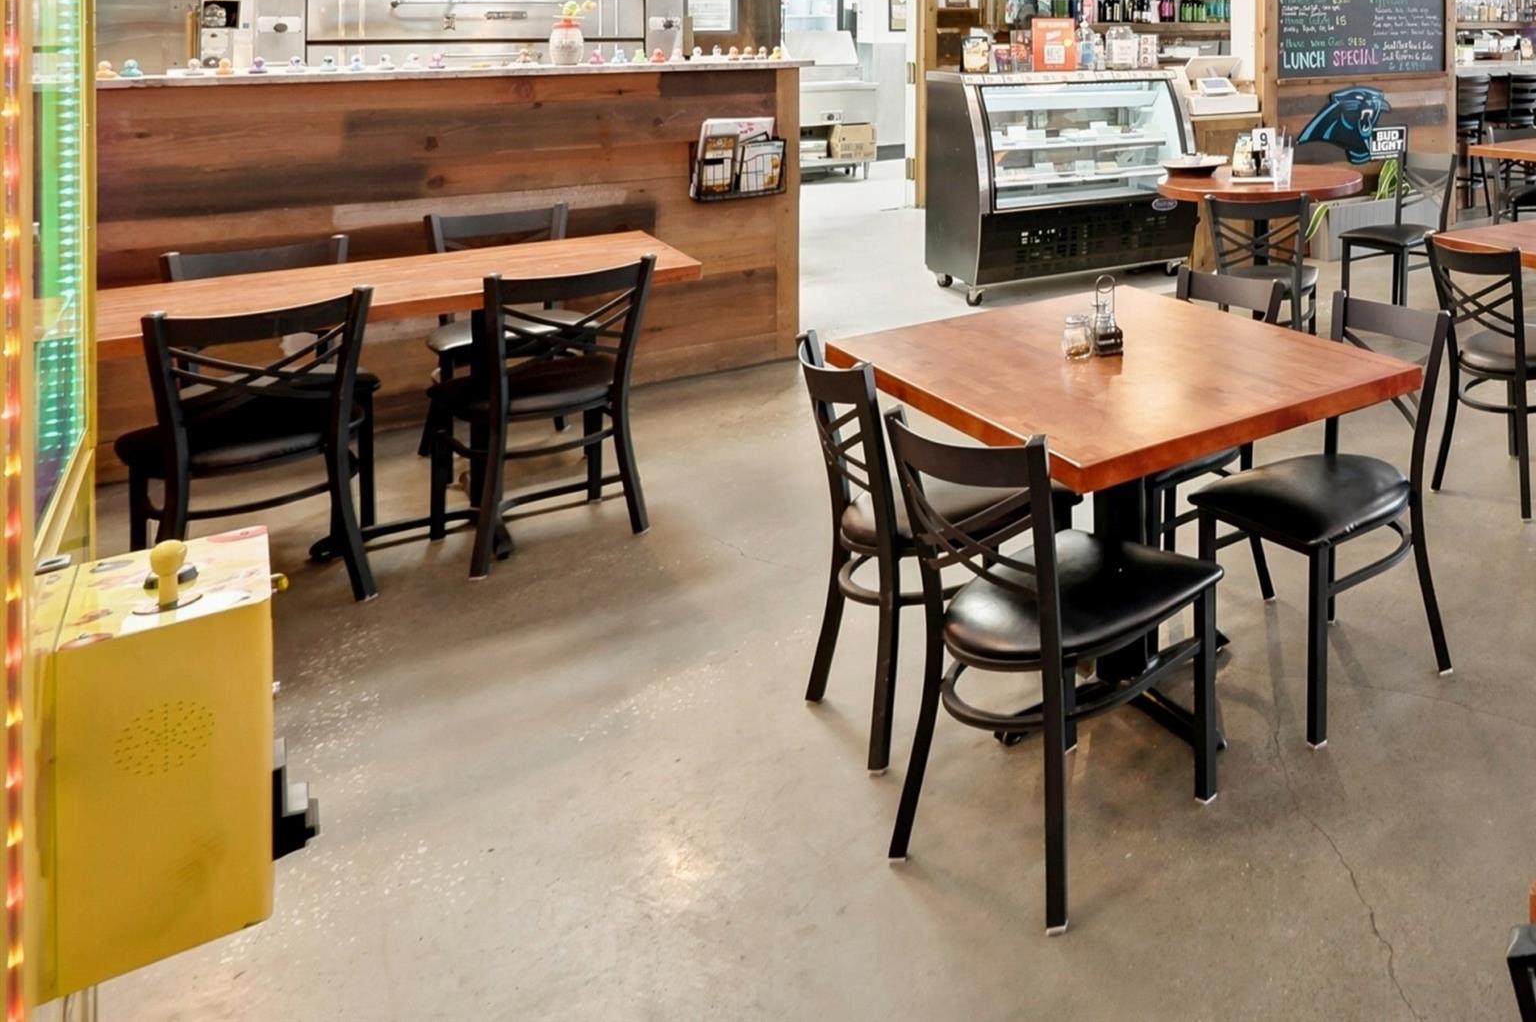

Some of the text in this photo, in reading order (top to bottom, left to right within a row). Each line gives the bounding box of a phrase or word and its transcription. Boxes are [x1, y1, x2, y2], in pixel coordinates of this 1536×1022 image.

[1283, 50, 1326, 70] LUNCH
[1332, 48, 1379, 67] SPECIAL
[1259, 132, 1268, 147] 9
[1376, 130, 1399, 141] BUD
[1372, 138, 1403, 152] LIGHT
